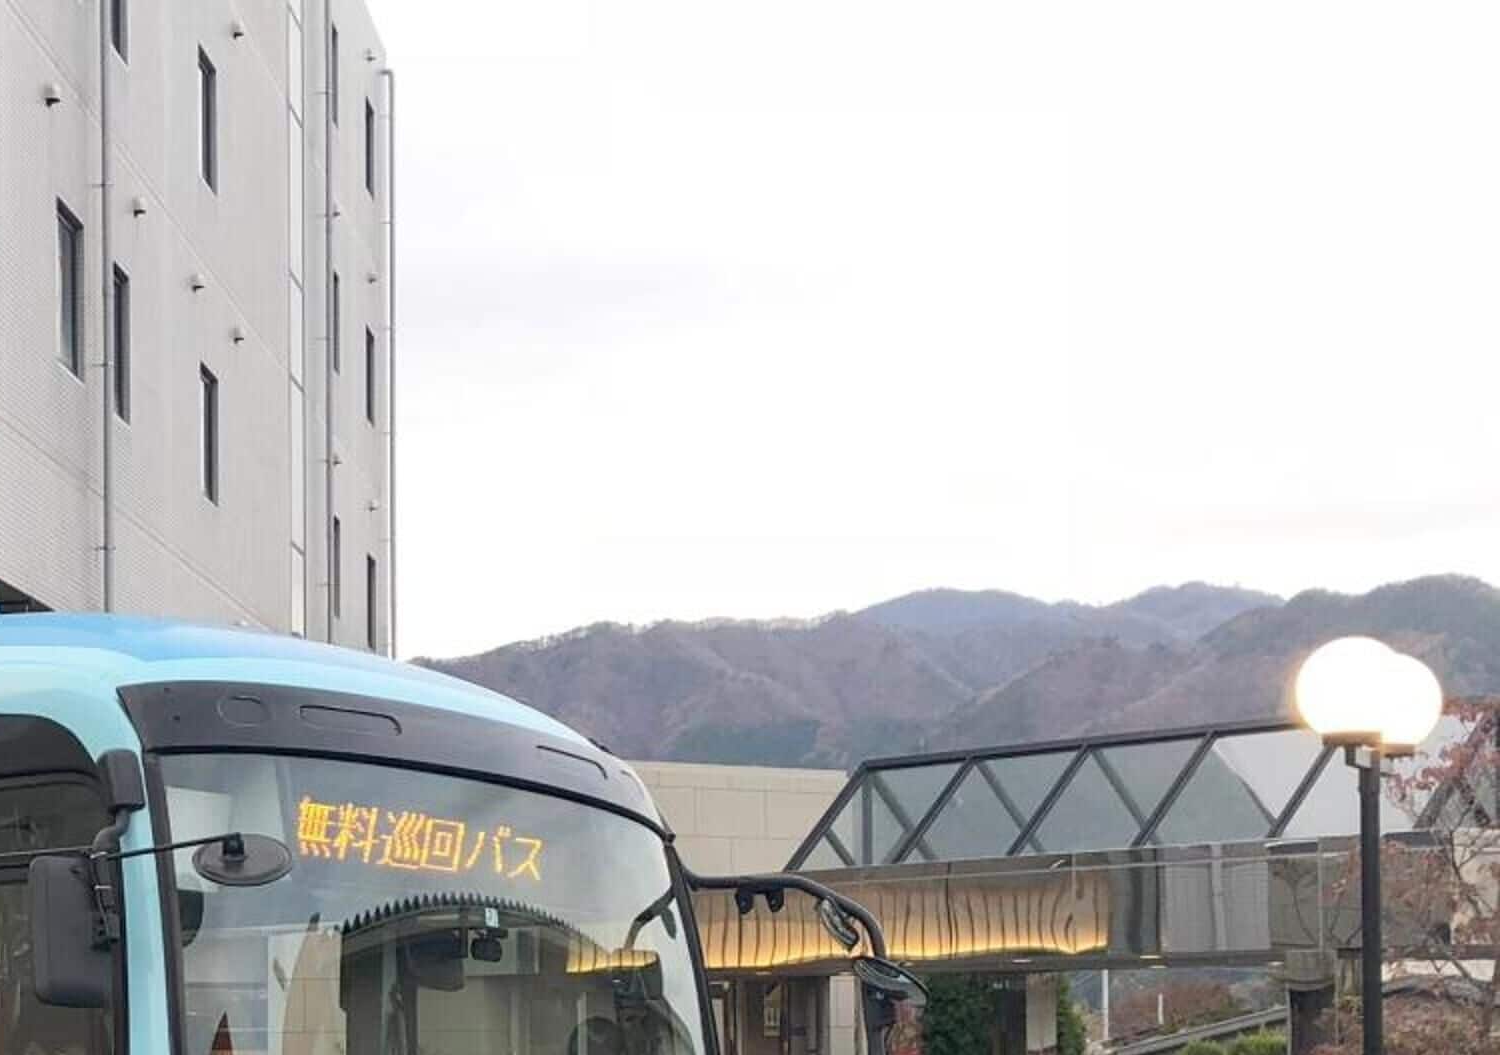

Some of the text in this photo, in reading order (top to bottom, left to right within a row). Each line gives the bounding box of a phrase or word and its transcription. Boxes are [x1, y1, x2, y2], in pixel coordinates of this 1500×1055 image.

[297, 795, 543, 881] 無料巡回バス
